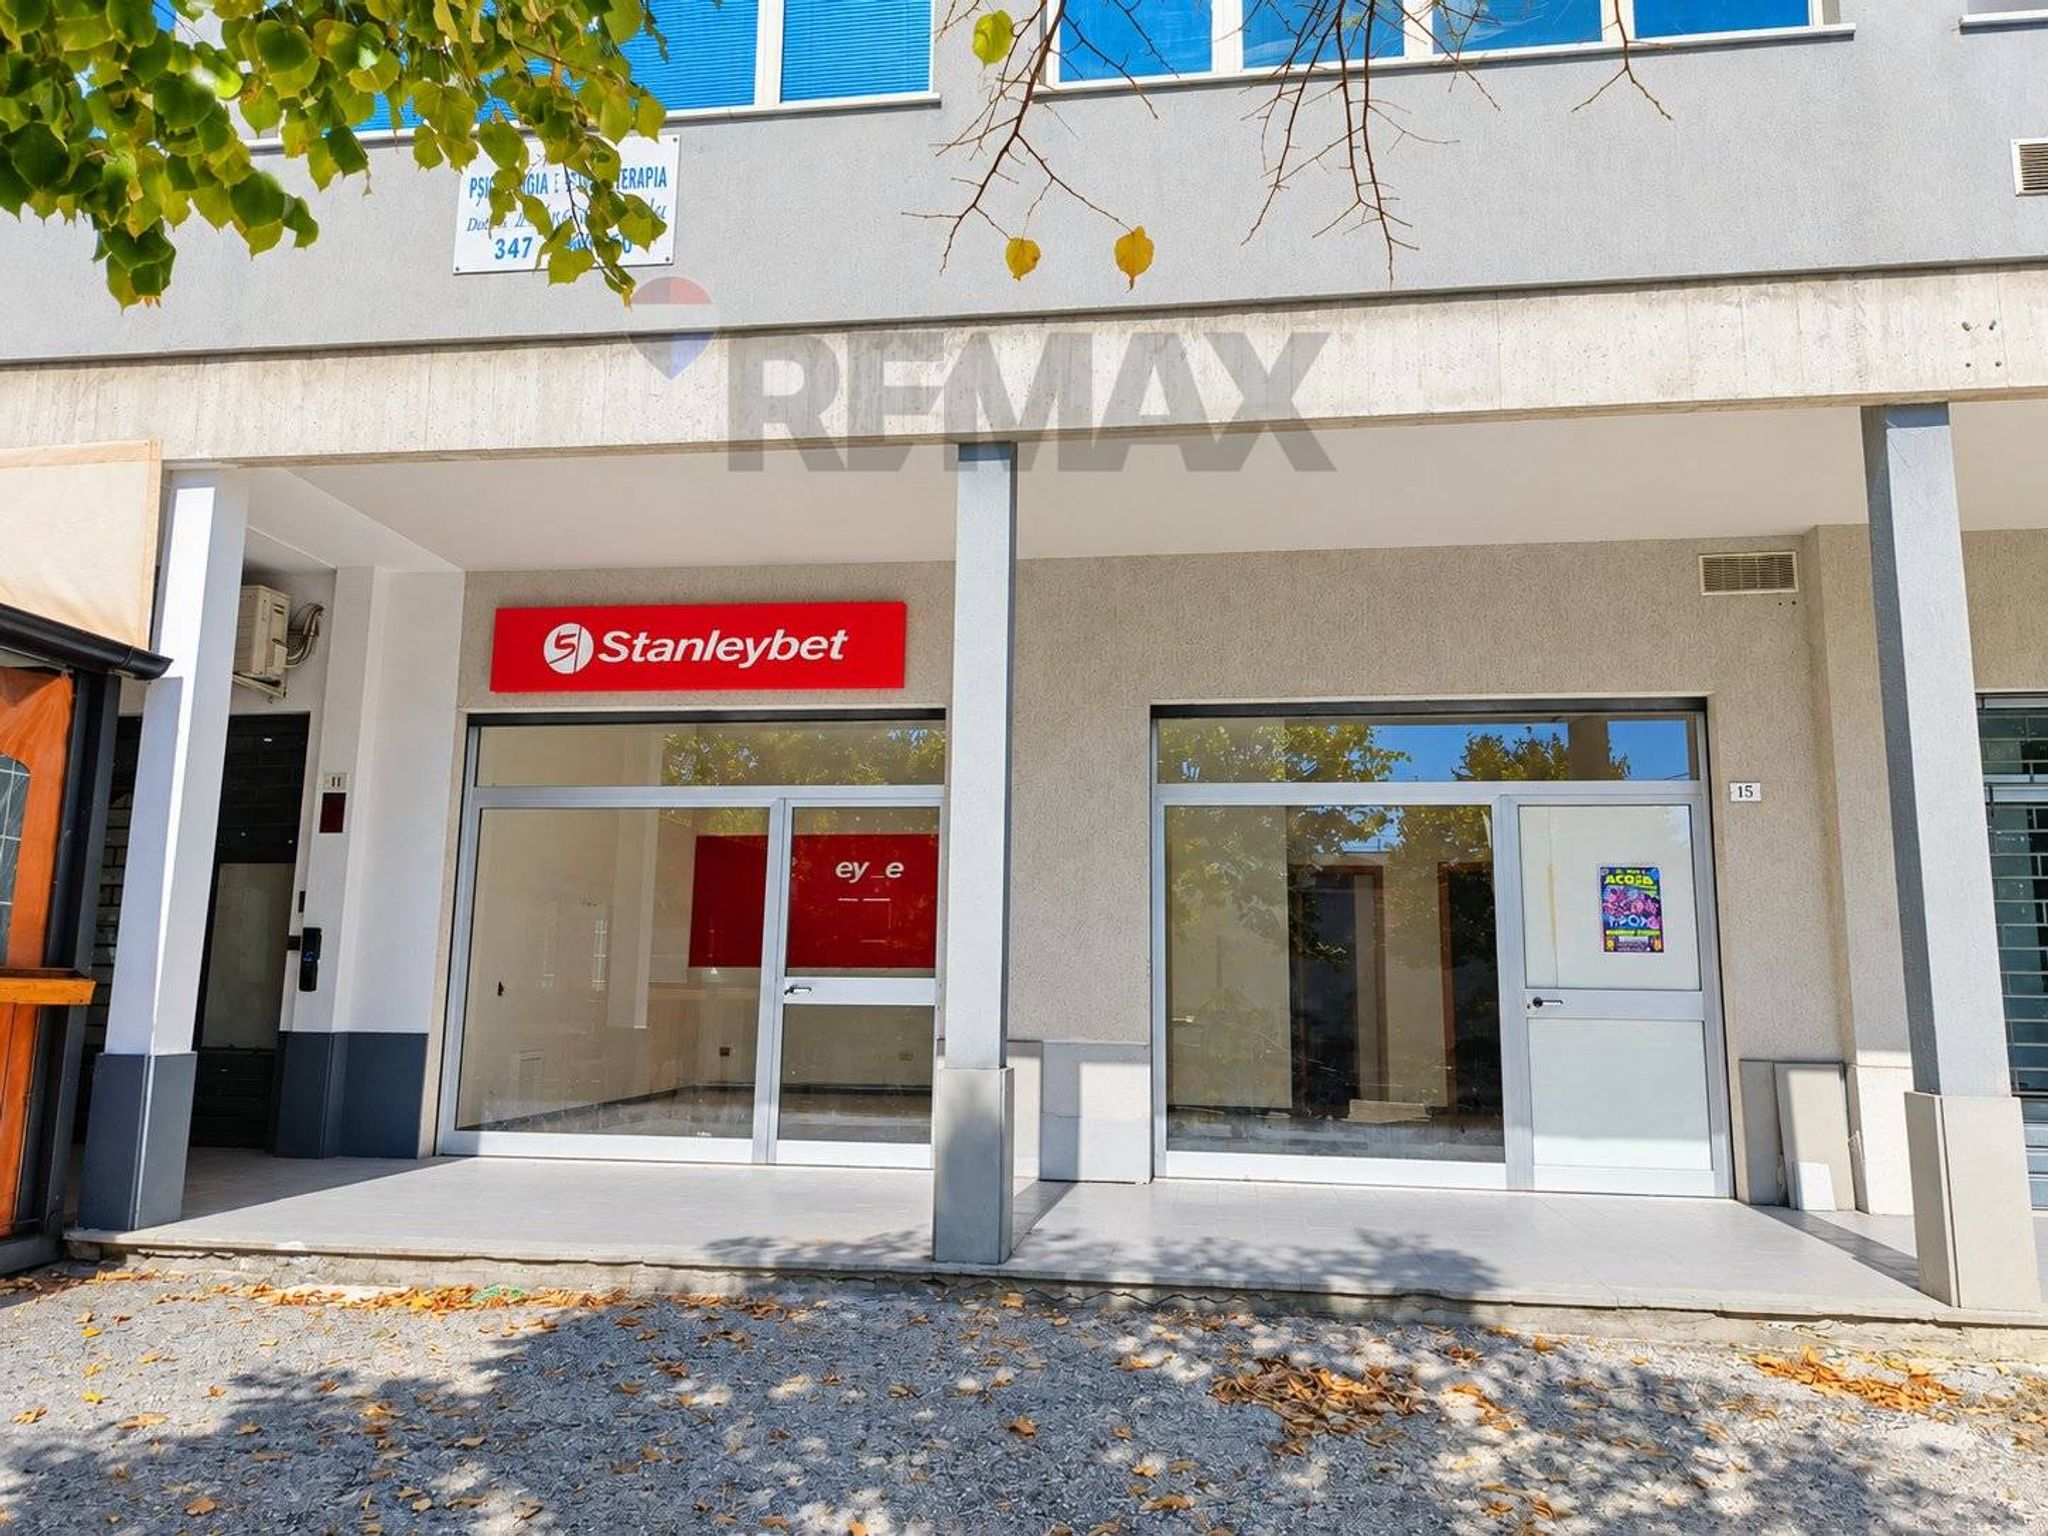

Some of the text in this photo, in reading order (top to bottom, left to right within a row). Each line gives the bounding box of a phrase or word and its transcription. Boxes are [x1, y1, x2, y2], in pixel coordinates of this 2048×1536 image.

[494, 236, 534, 260] 347
[598, 628, 849, 668] Stanleybet
[1737, 785, 1754, 798] 15
